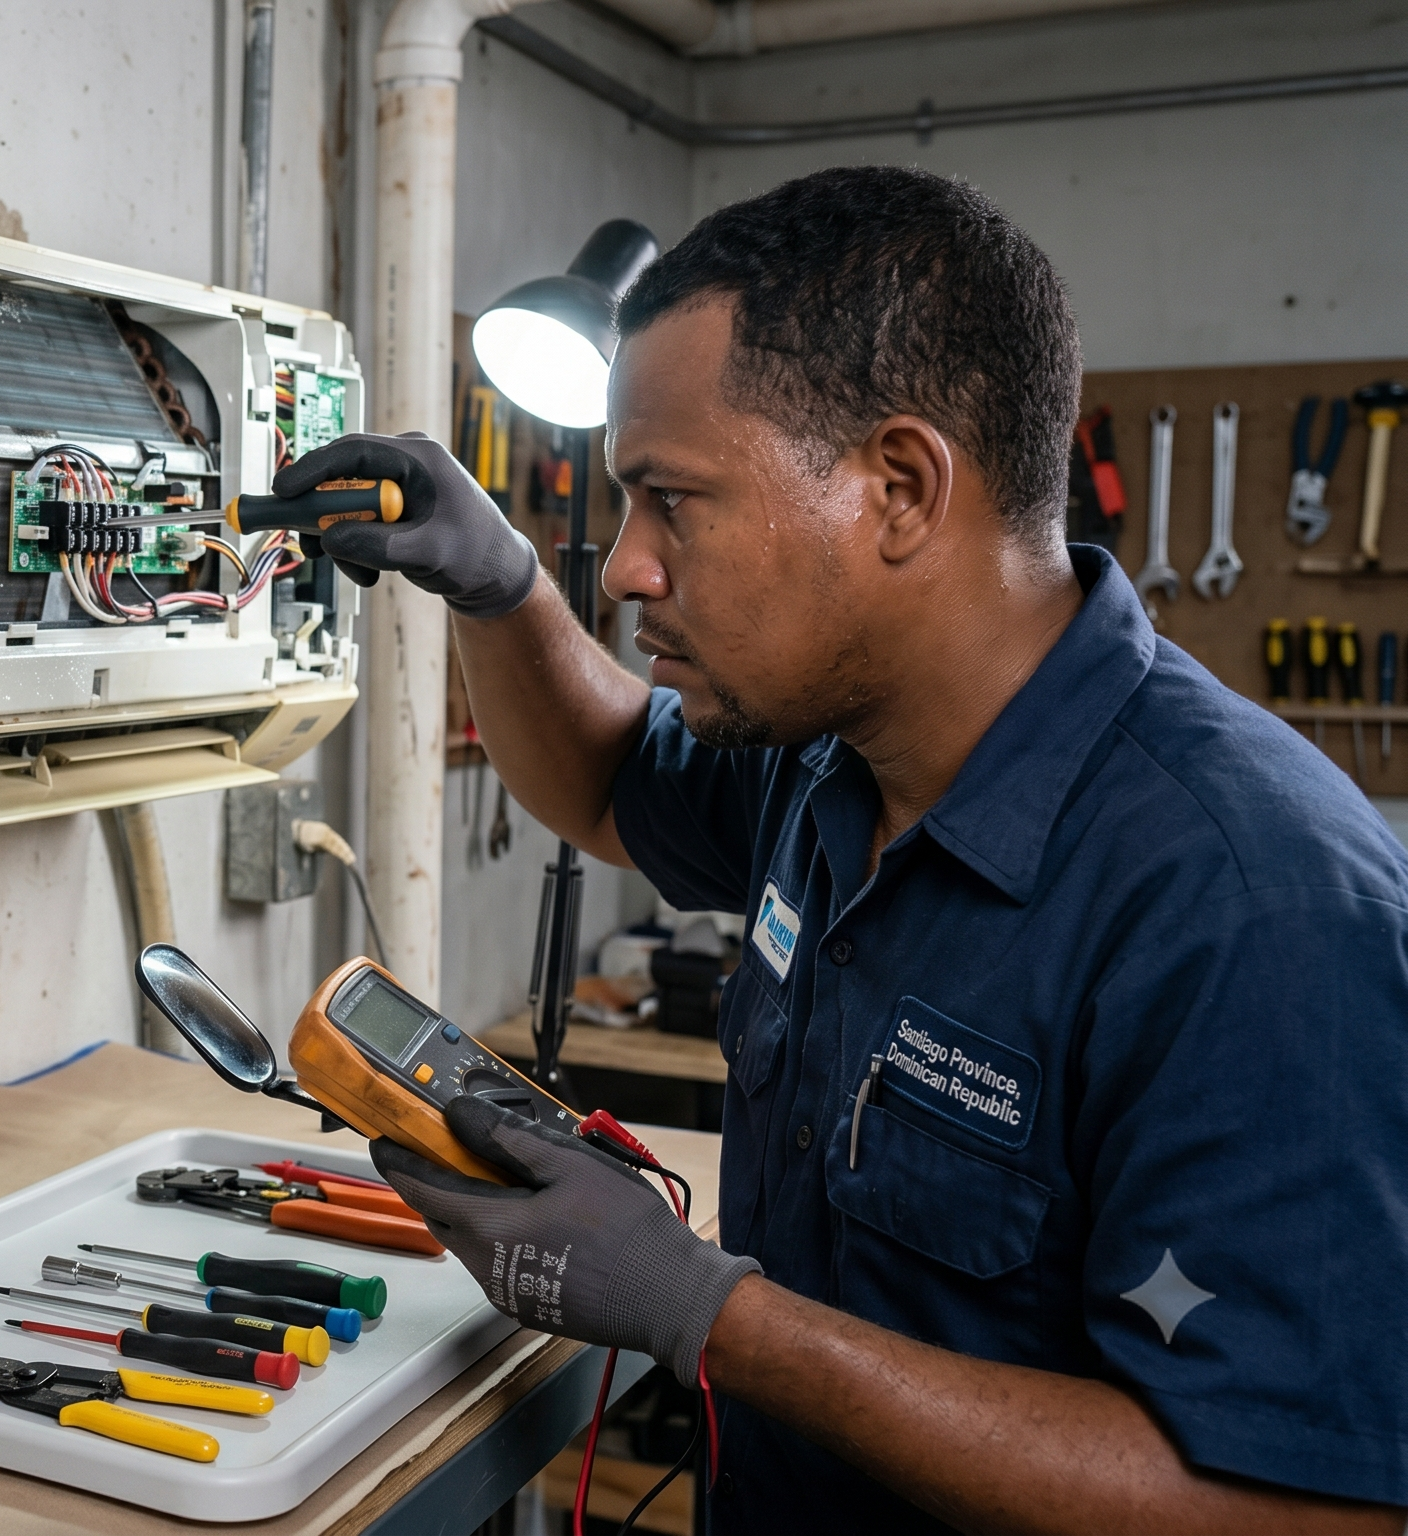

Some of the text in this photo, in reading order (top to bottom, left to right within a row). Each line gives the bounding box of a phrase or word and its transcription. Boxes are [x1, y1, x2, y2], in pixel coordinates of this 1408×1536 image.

[886, 1042, 1021, 1125] Dominican Republic
[949, 1047, 1021, 1100] Province,
